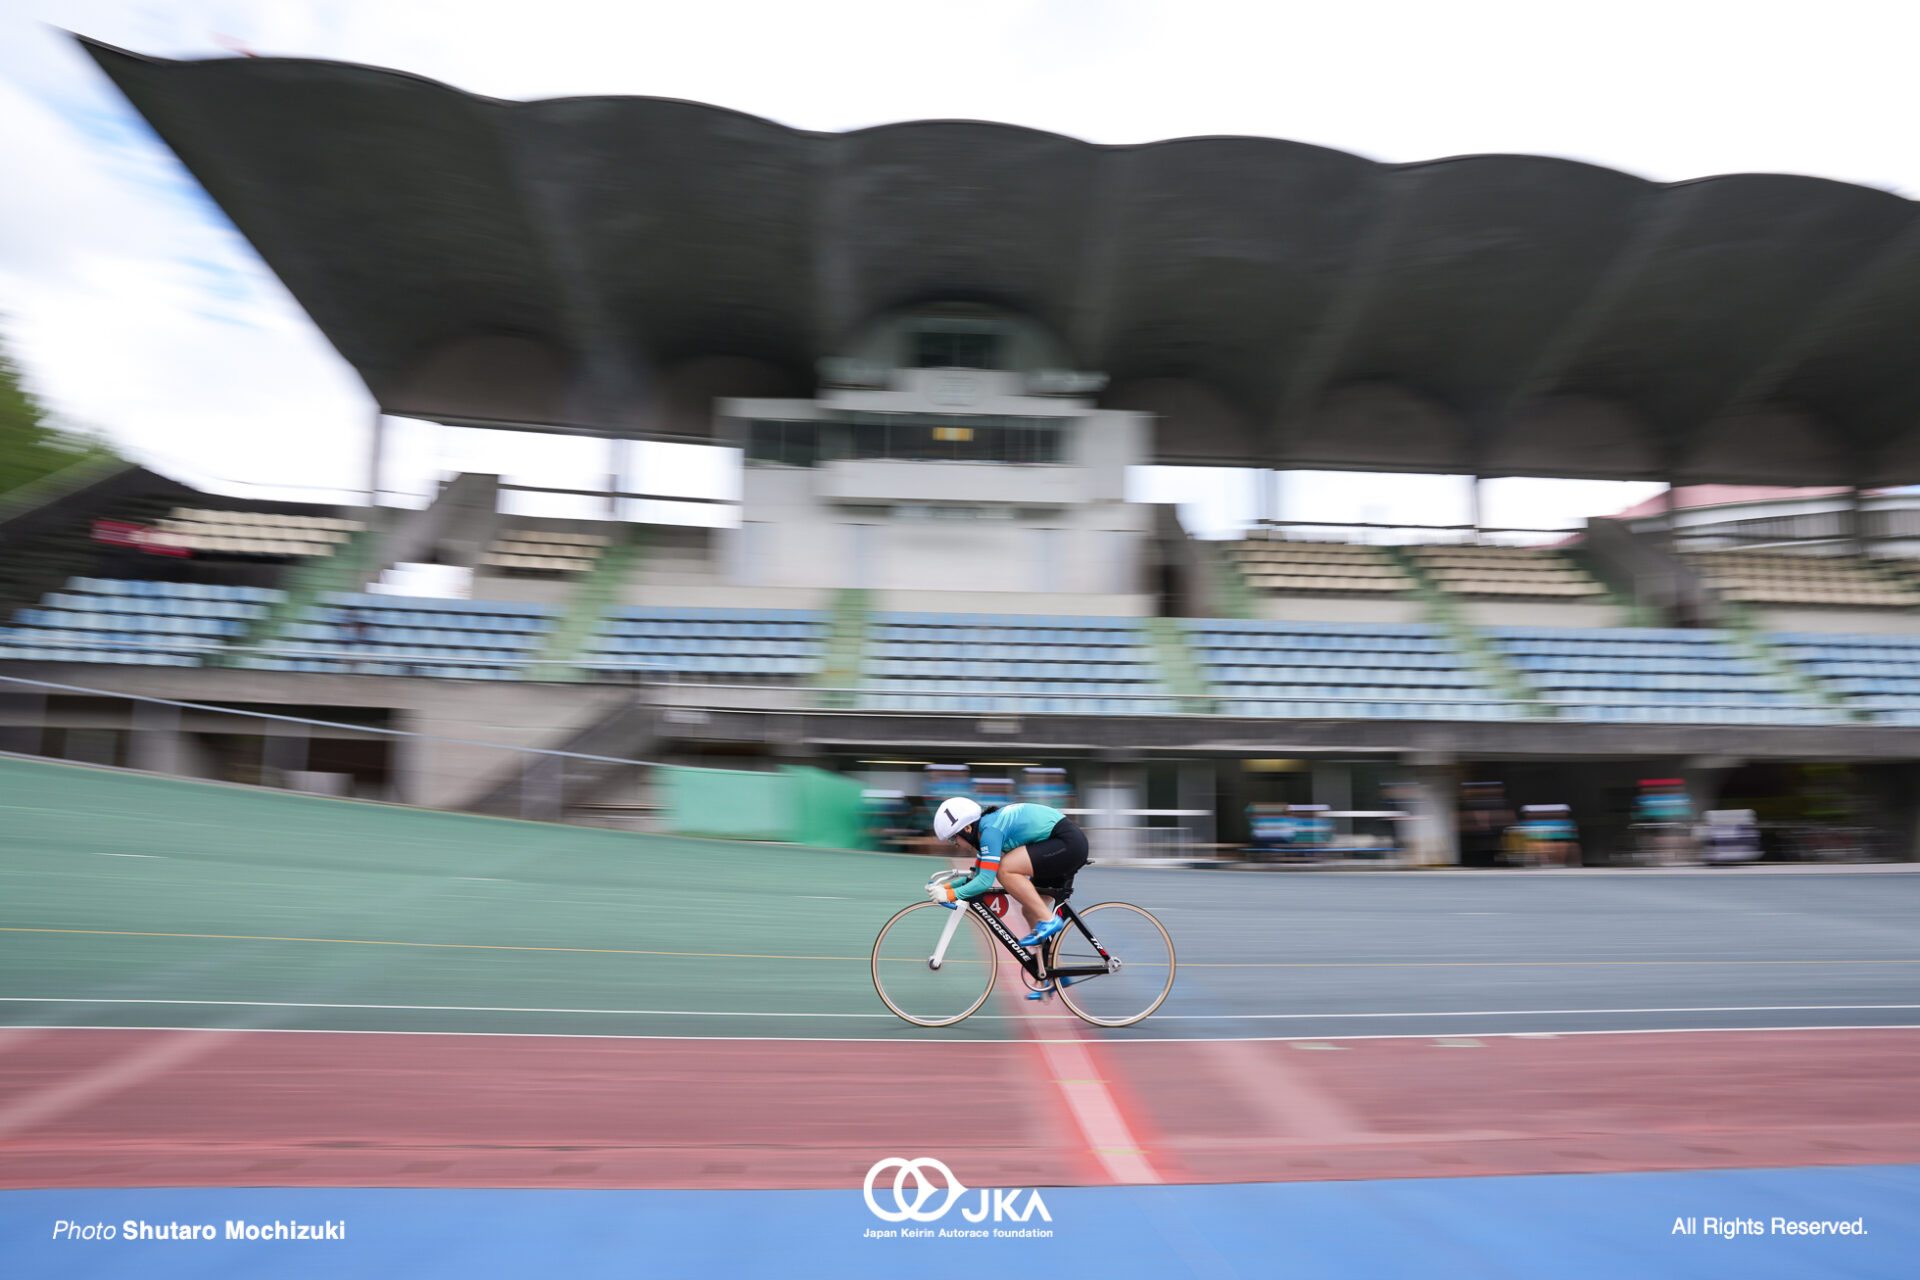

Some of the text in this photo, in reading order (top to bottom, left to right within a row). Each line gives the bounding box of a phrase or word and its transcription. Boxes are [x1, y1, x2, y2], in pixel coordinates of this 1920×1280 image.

[944, 808, 958, 826] 1
[990, 897, 1001, 914] 4
[972, 902, 1032, 962] BRIDGESTONE
